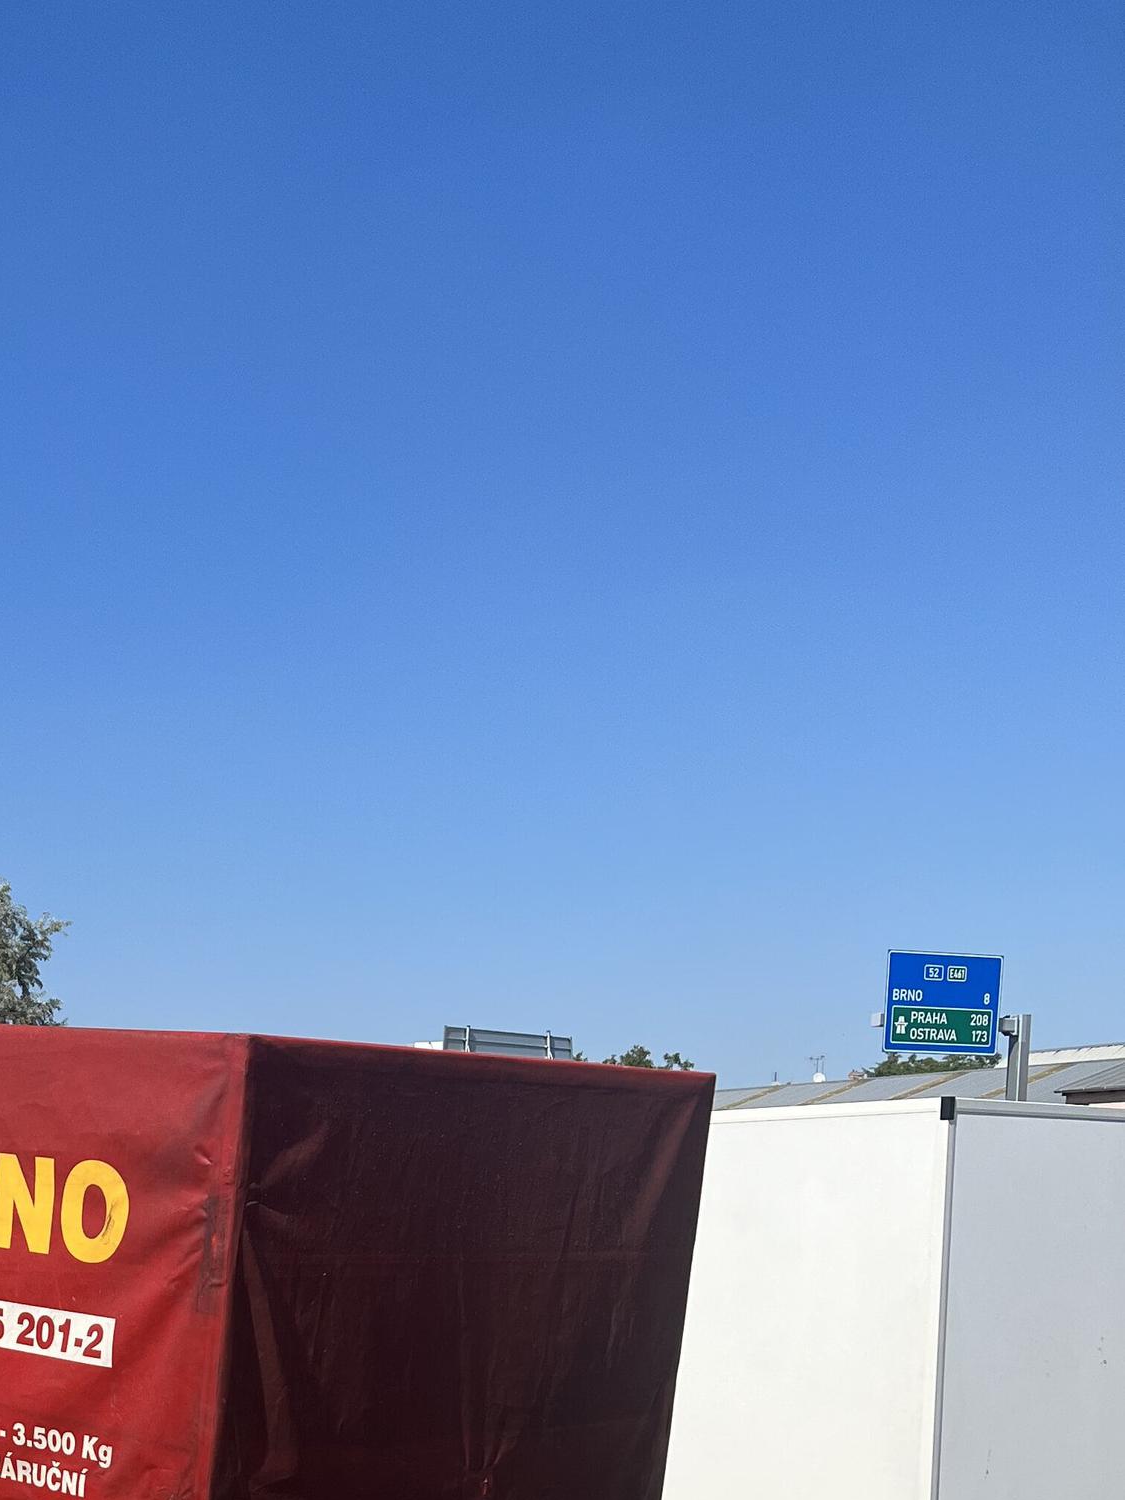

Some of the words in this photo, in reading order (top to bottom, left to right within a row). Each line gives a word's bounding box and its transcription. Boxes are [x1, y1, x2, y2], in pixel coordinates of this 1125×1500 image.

[928, 967, 940, 978] 52
[949, 969, 965, 979] E461
[892, 988, 923, 1002] BRNO
[983, 992, 991, 1005] 8
[910, 1011, 948, 1025] PRAHA
[969, 1014, 989, 1027] 208
[909, 1027, 957, 1042] OSTRAVA
[971, 1030, 988, 1043] 173
[16, 1311, 104, 1359] 201-2
[12, 1422, 75, 1456] 3.500
[81, 1434, 113, 1469] Kg
